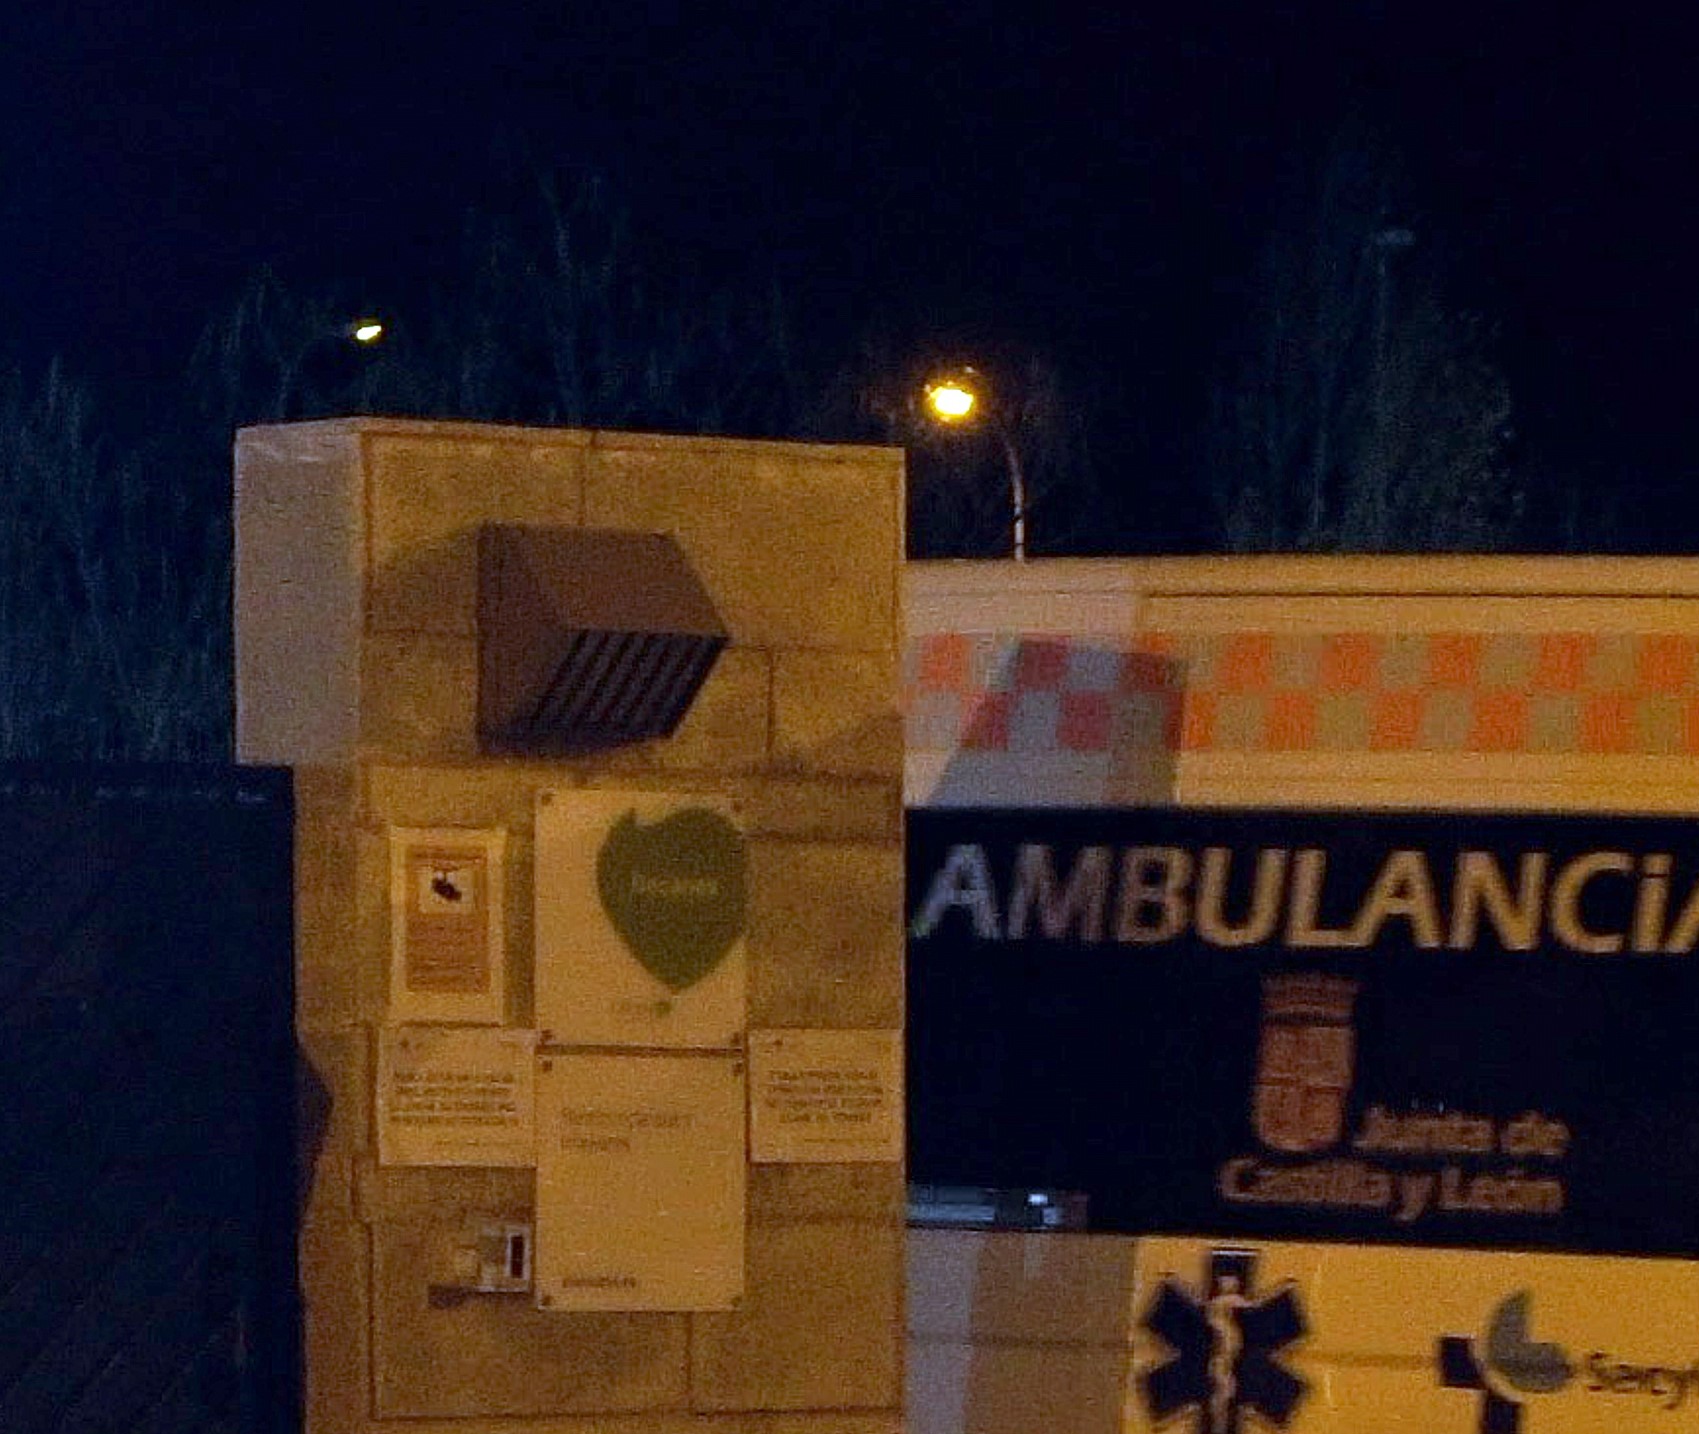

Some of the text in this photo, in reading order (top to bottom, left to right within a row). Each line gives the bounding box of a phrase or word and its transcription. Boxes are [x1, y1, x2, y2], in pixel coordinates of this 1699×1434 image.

[1353, 1105, 1571, 1158] Junta de
[1218, 1157, 1392, 1208] Castilla
[1395, 1175, 1435, 1223] y
